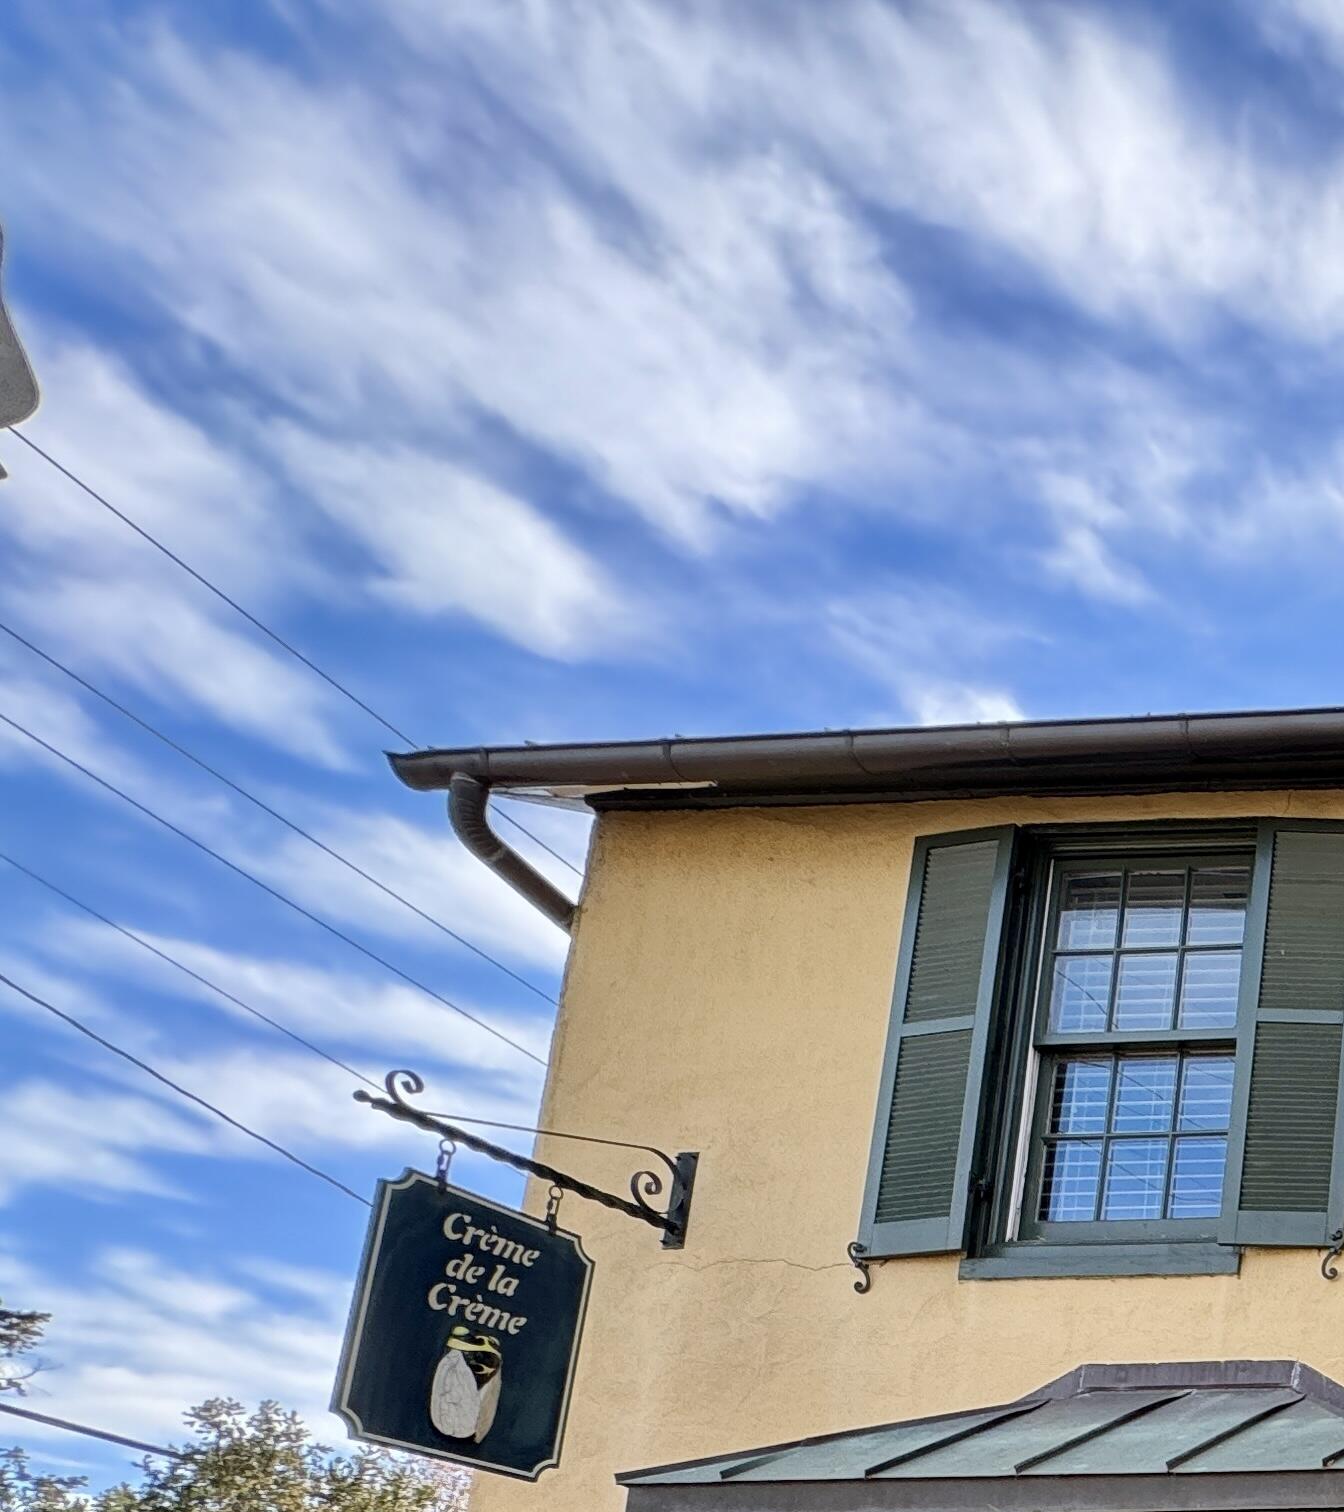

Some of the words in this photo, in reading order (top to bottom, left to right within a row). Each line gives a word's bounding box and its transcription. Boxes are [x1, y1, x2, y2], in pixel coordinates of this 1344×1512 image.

[443, 1212, 541, 1268] Crème
[445, 1253, 486, 1285] de
[487, 1264, 520, 1297] la
[427, 1282, 528, 1336] Crème
